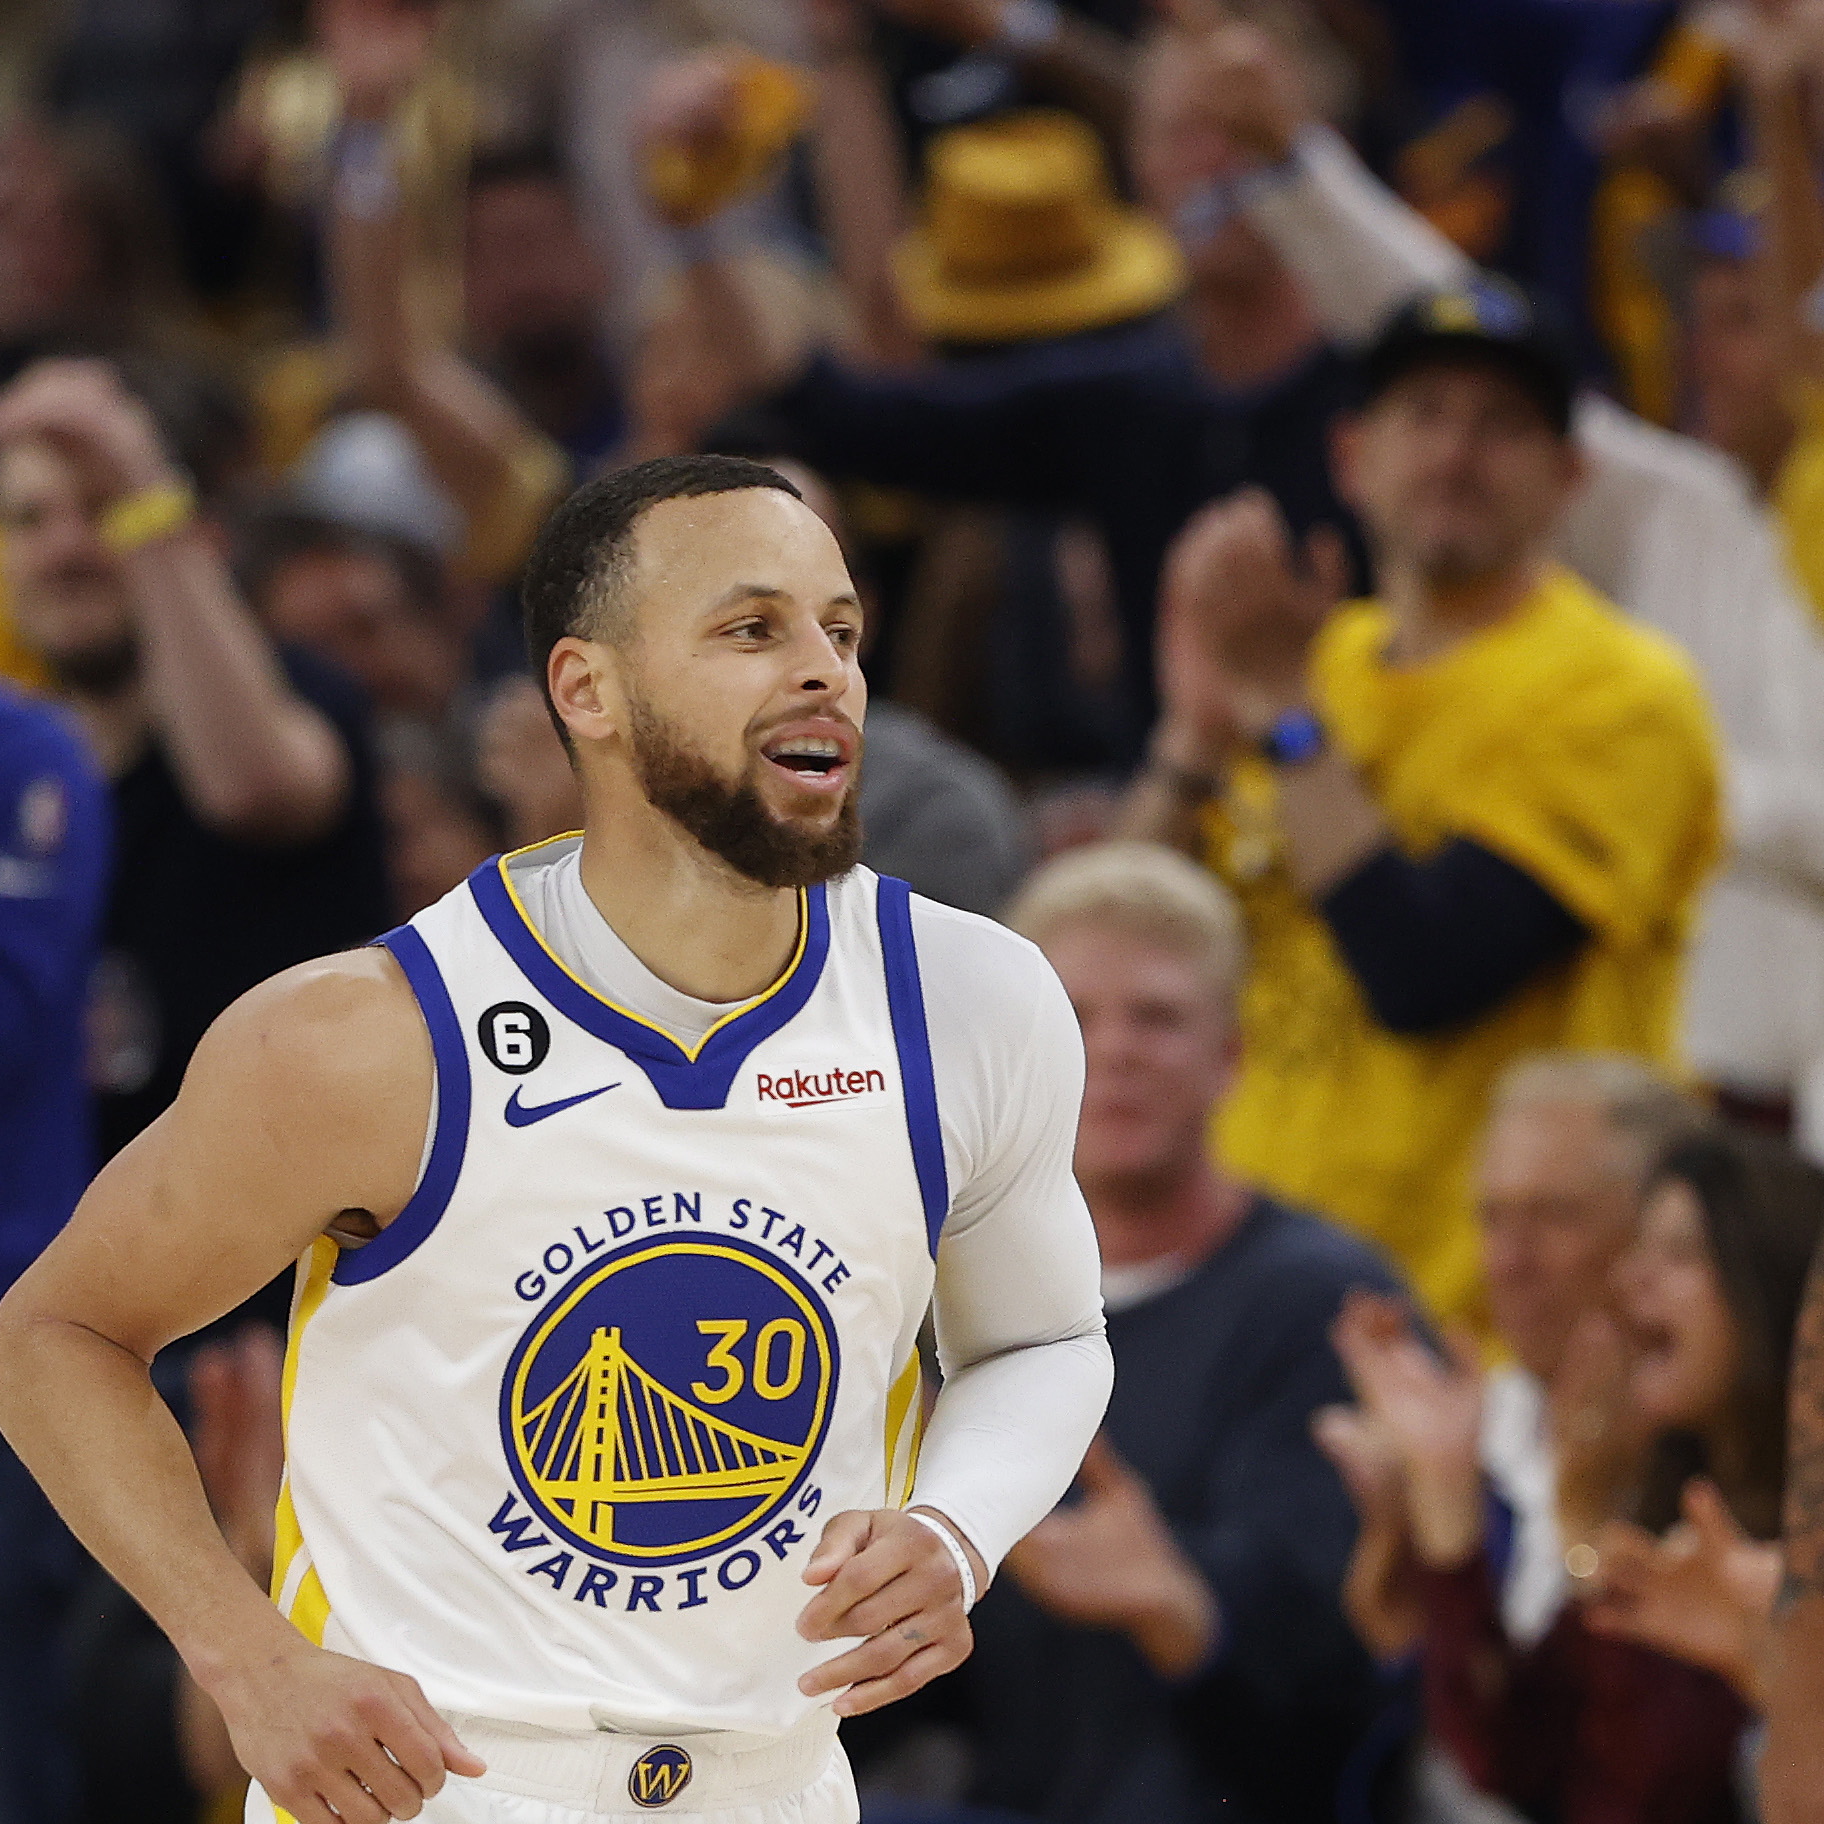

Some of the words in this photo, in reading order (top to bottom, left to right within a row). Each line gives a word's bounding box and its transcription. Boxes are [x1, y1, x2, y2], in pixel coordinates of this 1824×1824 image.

[492, 1011, 535, 1067] 6
[757, 1067, 886, 1104] Rakuten
[515, 1192, 701, 1302] GOLDEN
[729, 1199, 850, 1295] STATE
[690, 1318, 807, 1404] 30
[487, 1483, 823, 1612] WARRIORS
